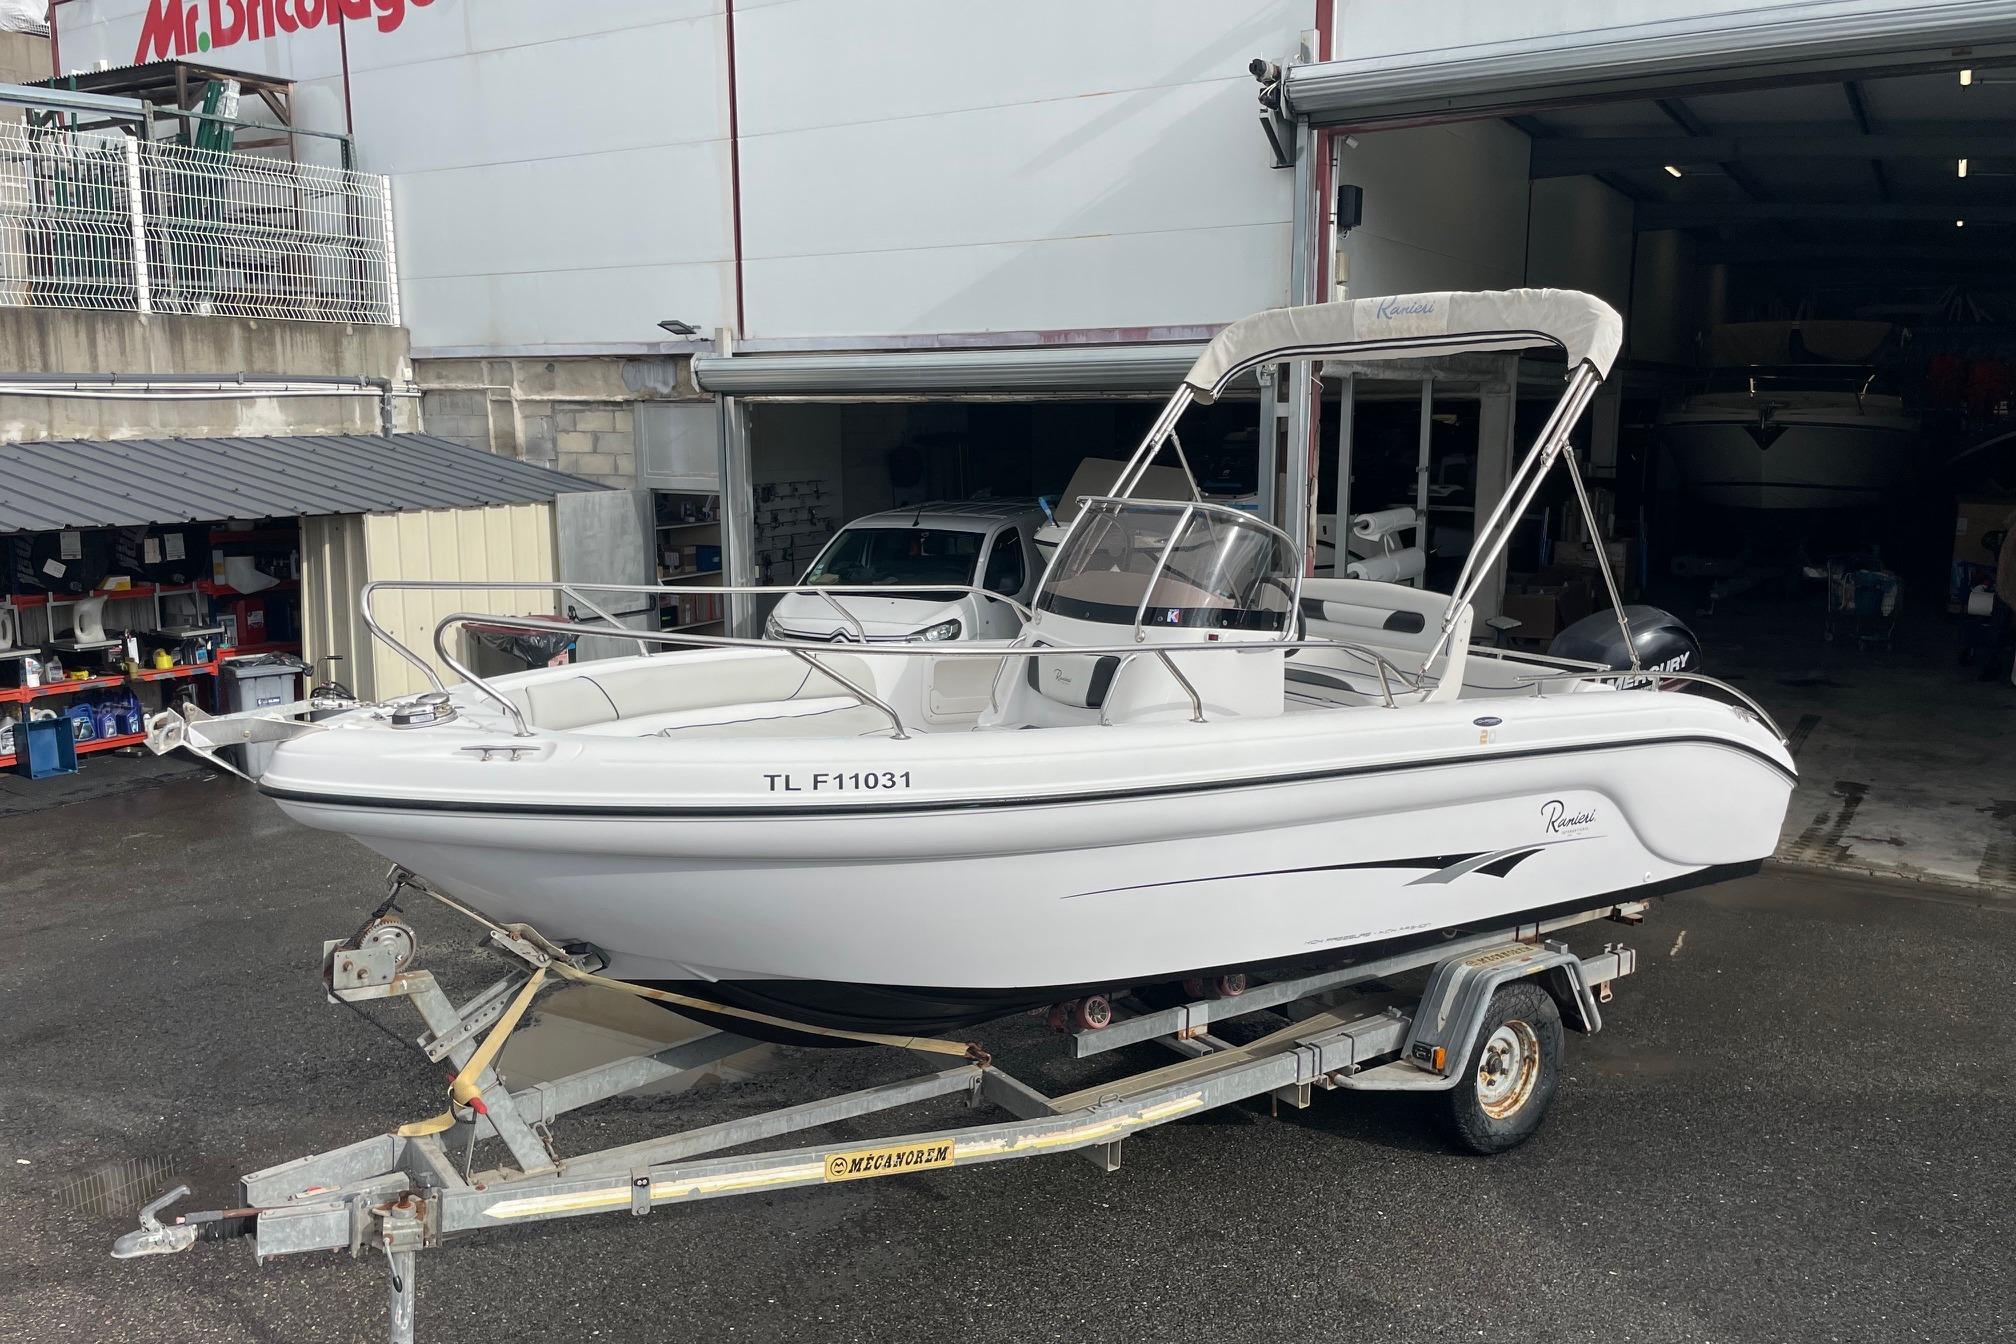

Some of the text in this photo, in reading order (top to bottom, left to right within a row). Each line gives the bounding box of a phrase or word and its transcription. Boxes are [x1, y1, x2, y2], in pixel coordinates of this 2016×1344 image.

[763, 771, 911, 791] TL F11031
[1541, 800, 1597, 833] Ranieri
